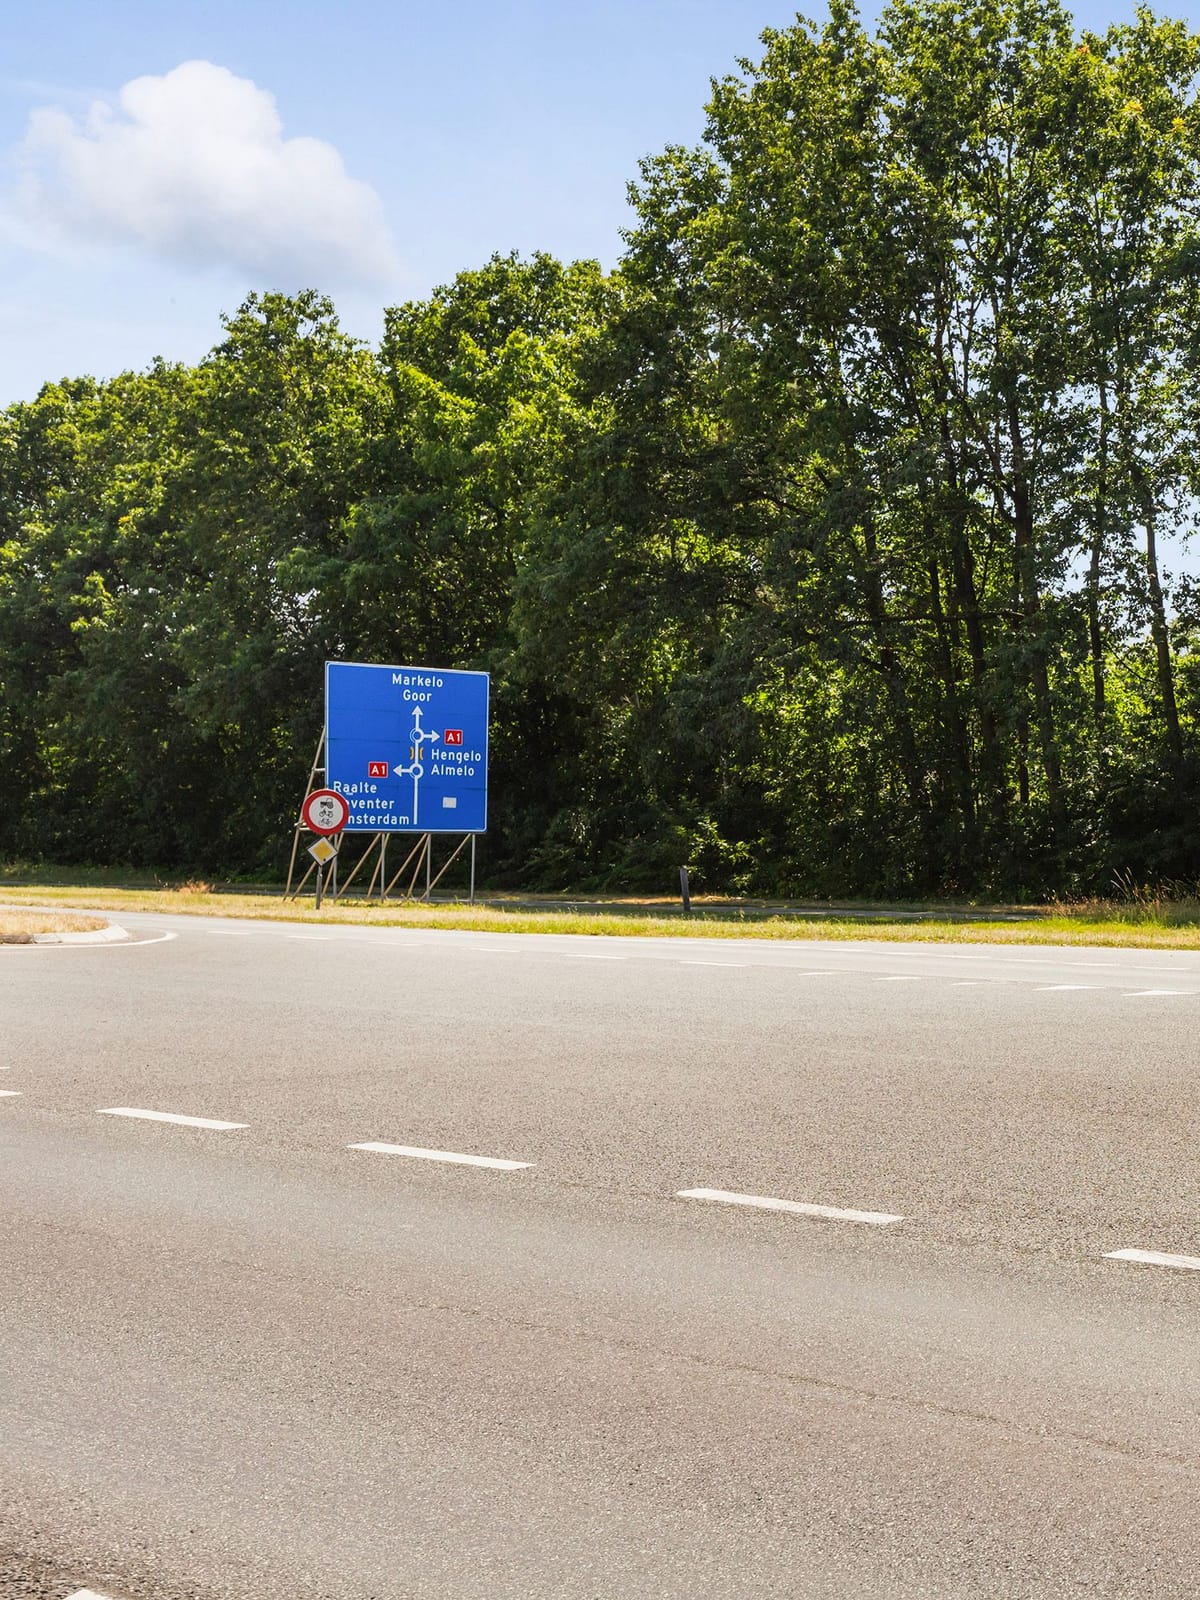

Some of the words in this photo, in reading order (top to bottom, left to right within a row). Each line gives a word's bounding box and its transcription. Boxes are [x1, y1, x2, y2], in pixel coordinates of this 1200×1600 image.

[392, 673, 444, 688] Markelo
[403, 689, 432, 702] Goor
[447, 732, 461, 743] A1
[431, 749, 481, 764] Hengelo
[371, 765, 386, 775] A1
[431, 764, 475, 777] Almelo
[333, 781, 377, 793] Raalte
[347, 798, 395, 809] venter
